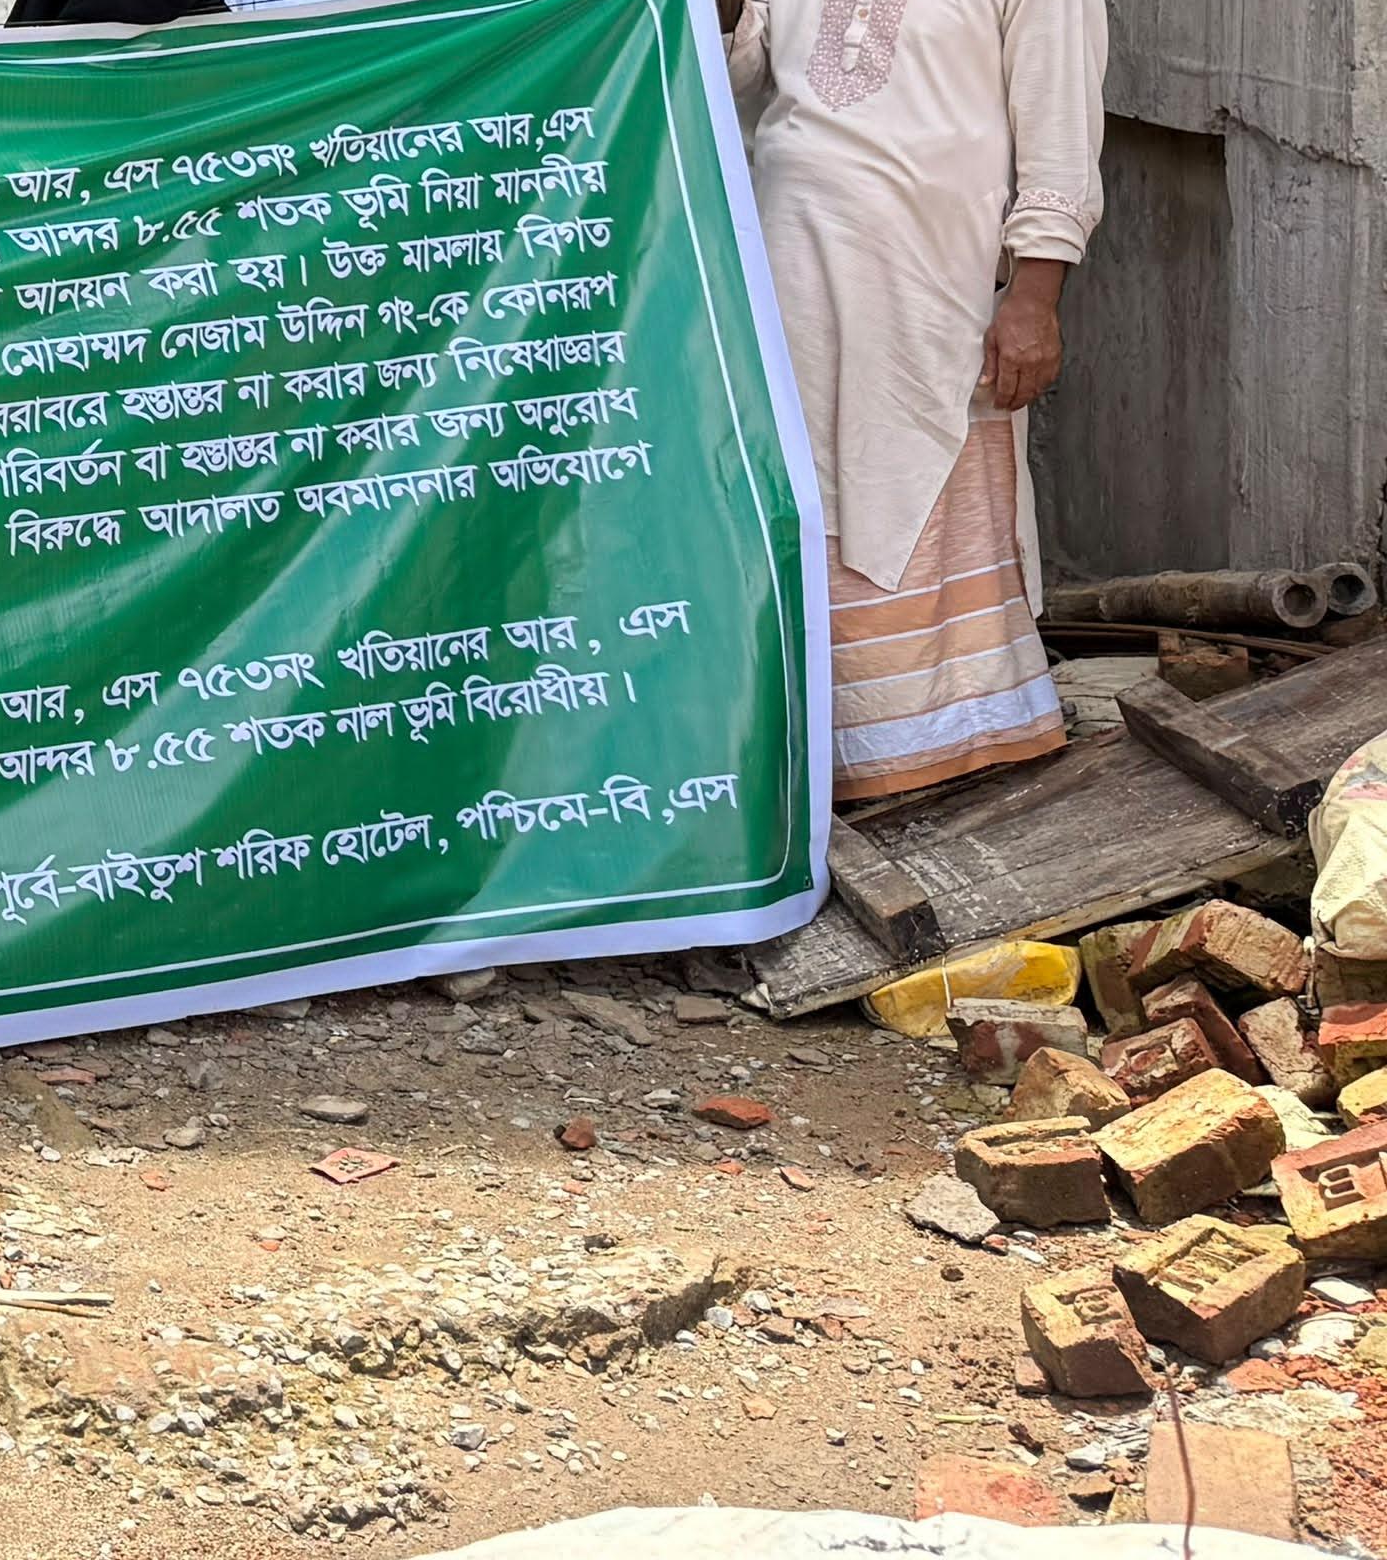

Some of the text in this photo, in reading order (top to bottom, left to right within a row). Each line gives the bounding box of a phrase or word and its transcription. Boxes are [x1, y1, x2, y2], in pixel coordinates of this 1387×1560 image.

[105, 159, 163, 193] এস
[172, 144, 297, 184] ৭৫৩নং
[310, 122, 463, 167] খতিয়ানের
[134, 208, 222, 245] ৮.৫৫
[236, 193, 331, 231] শতক
[339, 174, 411, 231] ভূমি
[419, 168, 483, 212] নিয়া
[491, 154, 607, 203] মাননীয়
[14, 272, 131, 314] আনয়ন
[140, 259, 218, 299] করা
[322, 238, 388, 278] উক্ত
[398, 230, 504, 272] মামলায়
[514, 214, 613, 258] বিগত
[2, 329, 151, 375] মোহাম্মদ
[161, 315, 268, 358] নেজাম
[276, 297, 369, 343] উদ্দিন
[483, 271, 617, 319] কোনরূপ
[116, 380, 227, 423] হস্তান্তর
[234, 371, 274, 409] না
[280, 362, 368, 402] করার
[374, 353, 439, 389] জন্য
[444, 331, 627, 381] নিষেধাজ্ঞার
[132, 442, 171, 481] বা
[177, 432, 279, 476] হস্তান্তর
[284, 424, 328, 460] না
[333, 414, 419, 453] করার
[423, 403, 507, 440] জন্য
[512, 387, 638, 436] অনুরোধ
[5, 509, 125, 555] বিরুদ্ধে
[138, 492, 284, 537] আদালত
[294, 464, 477, 517] অবমাননার
[488, 440, 652, 491] অভিযোগে
[103, 672, 161, 709] এস
[179, 653, 324, 700] ৭৫৩নং
[338, 627, 491, 679] খতিয়ানের
[620, 601, 690, 639] এস
[105, 728, 215, 771] ৮.৫৫
[223, 712, 326, 754] শতক
[331, 703, 395, 741] নাল
[399, 682, 457, 743] ভূমি
[211, 829, 312, 878] শরিফ
